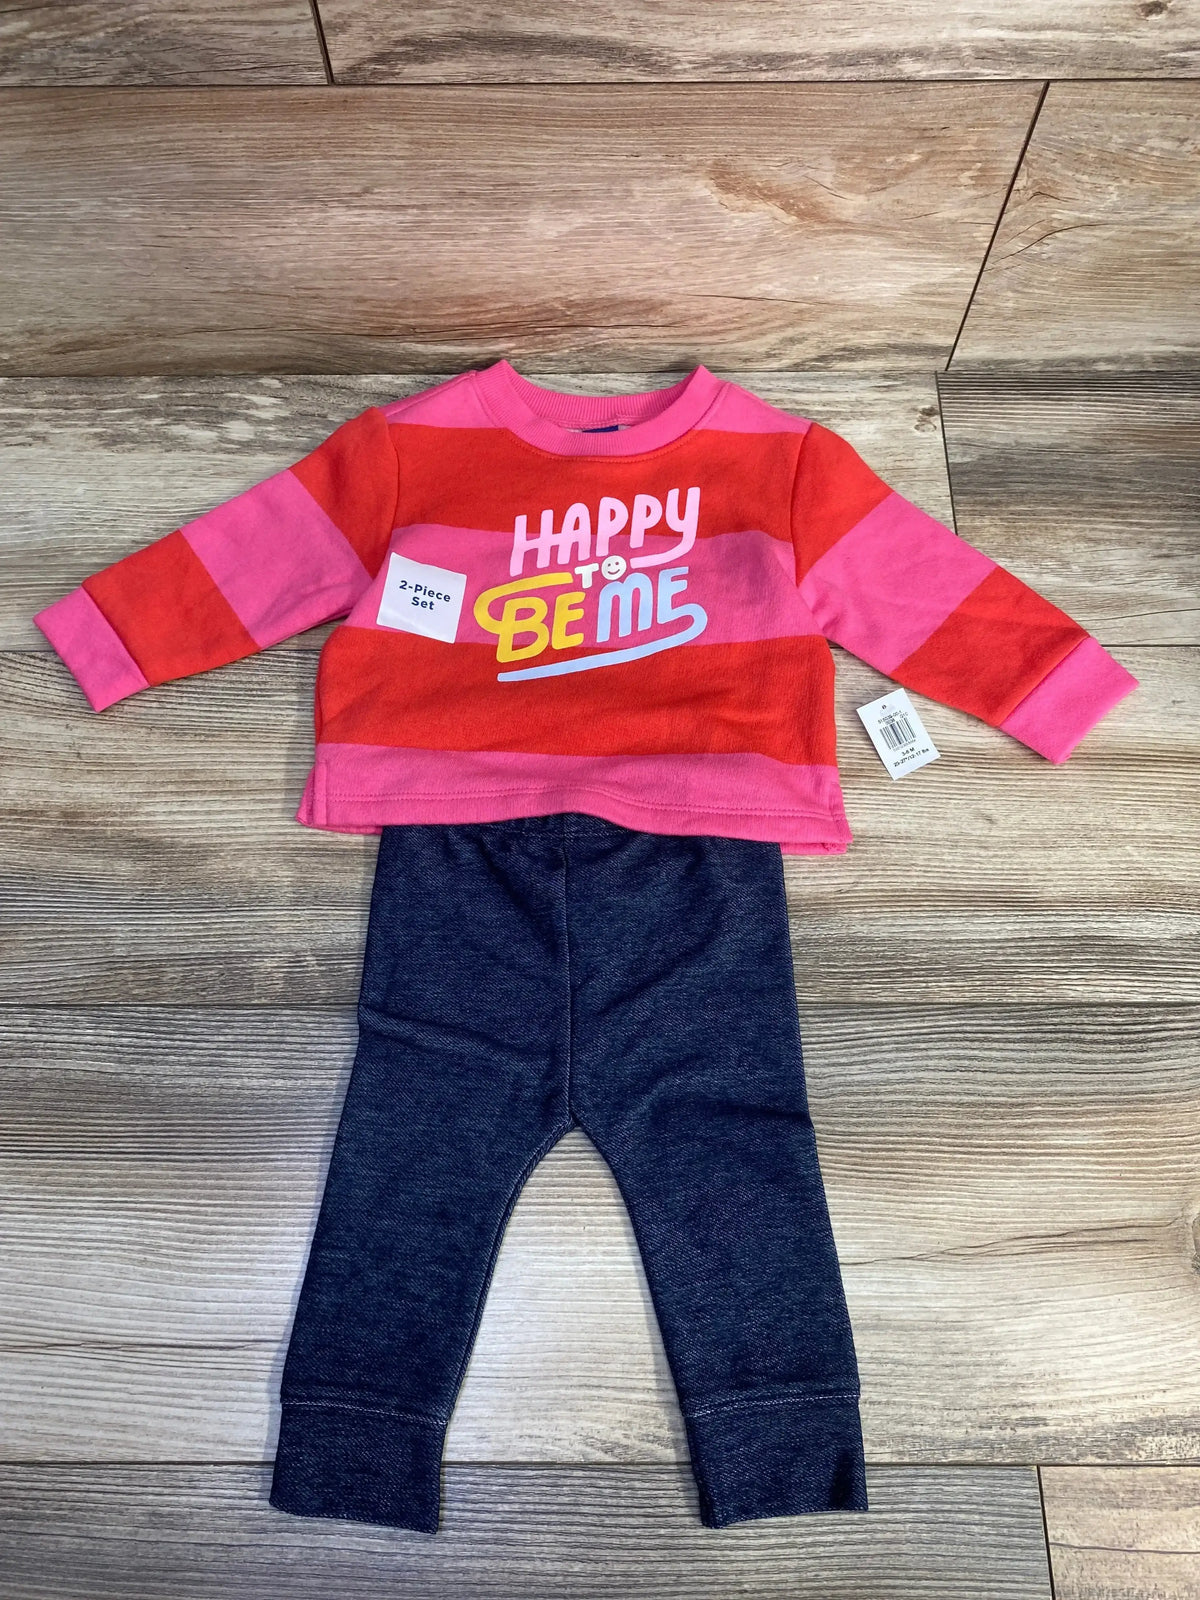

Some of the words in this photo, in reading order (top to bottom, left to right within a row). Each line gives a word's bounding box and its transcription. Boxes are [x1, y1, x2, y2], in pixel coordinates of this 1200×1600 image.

[510, 487, 700, 577] HAPPY
[574, 555, 627, 589] TO
[399, 580, 451, 602] 2-Piece
[411, 596, 435, 611] Set
[474, 572, 586, 663] BE
[597, 566, 707, 643] ME
